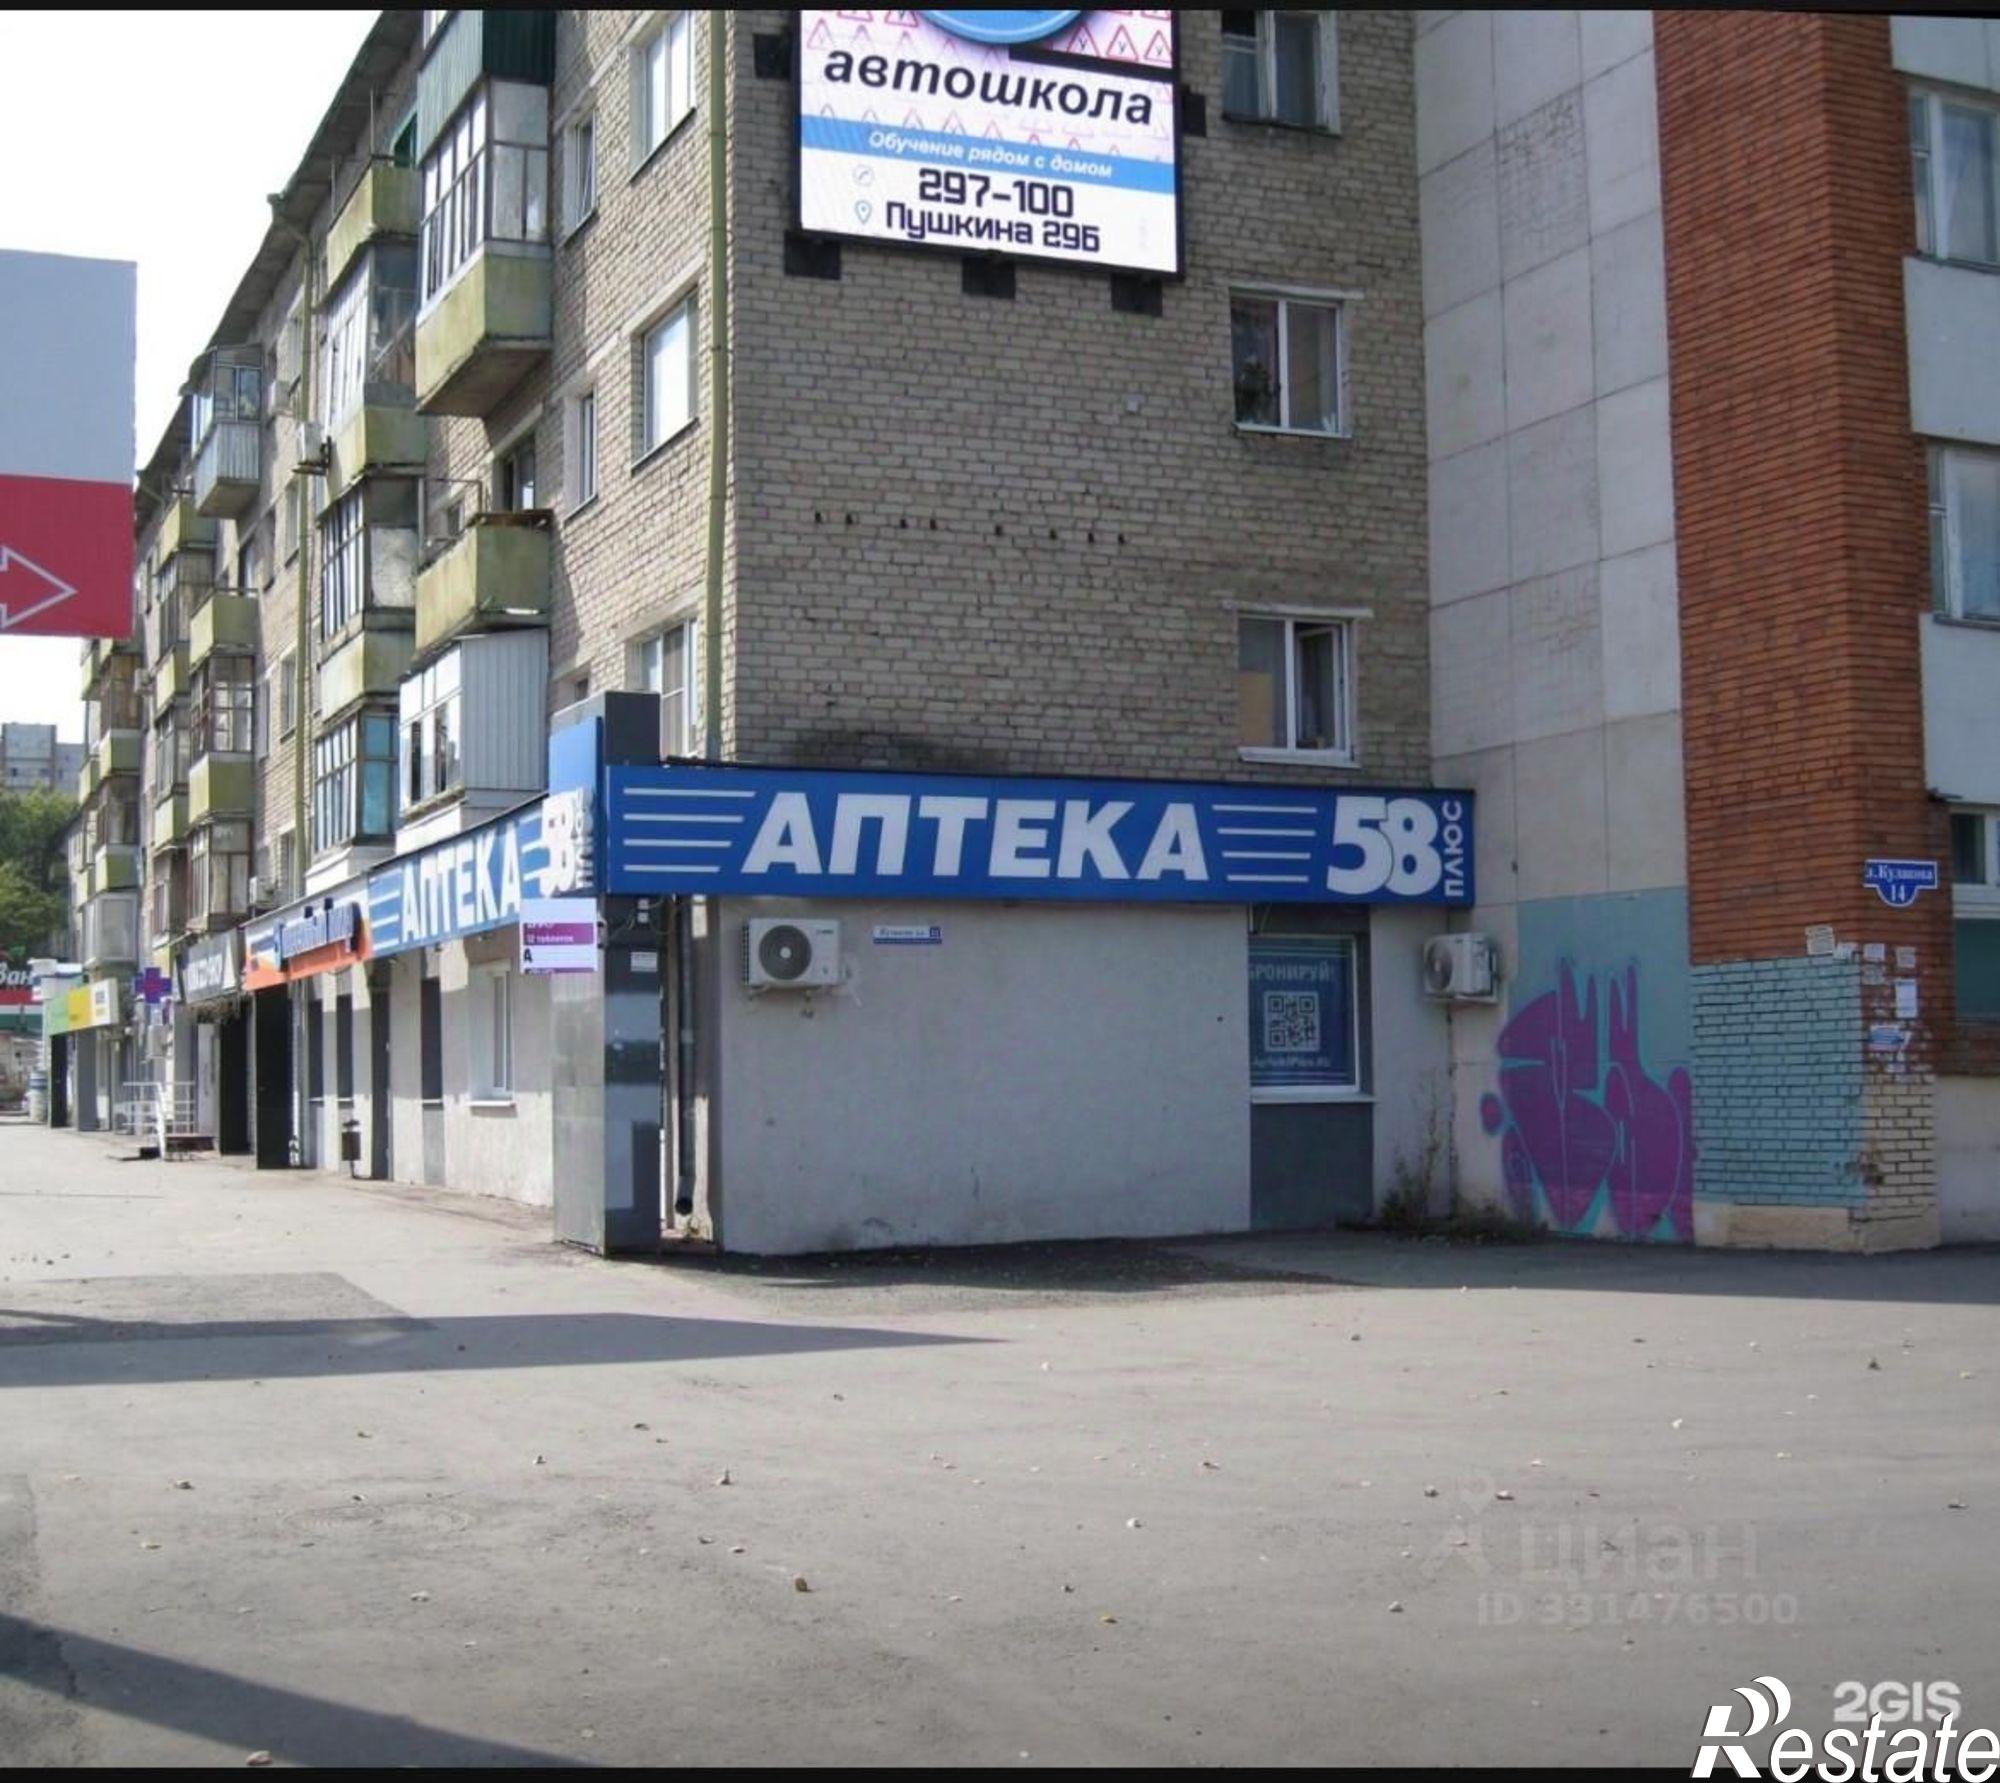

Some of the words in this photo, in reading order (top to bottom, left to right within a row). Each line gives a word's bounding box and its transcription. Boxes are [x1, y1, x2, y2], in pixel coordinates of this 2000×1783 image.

[824, 50, 1152, 125] автошкола
[869, 130, 963, 159] Обучение
[968, 142, 1029, 167] рядом
[1034, 154, 1046, 168] с
[1050, 152, 1112, 178] домом
[886, 201, 1033, 244] Пушкина
[919, 168, 1074, 218] 297-100
[740, 792, 1208, 882] АПТЕКА
[1326, 796, 1442, 895] 58
[1442, 800, 1464, 896] ПЛЮС
[402, 820, 521, 943] АПТЕКА
